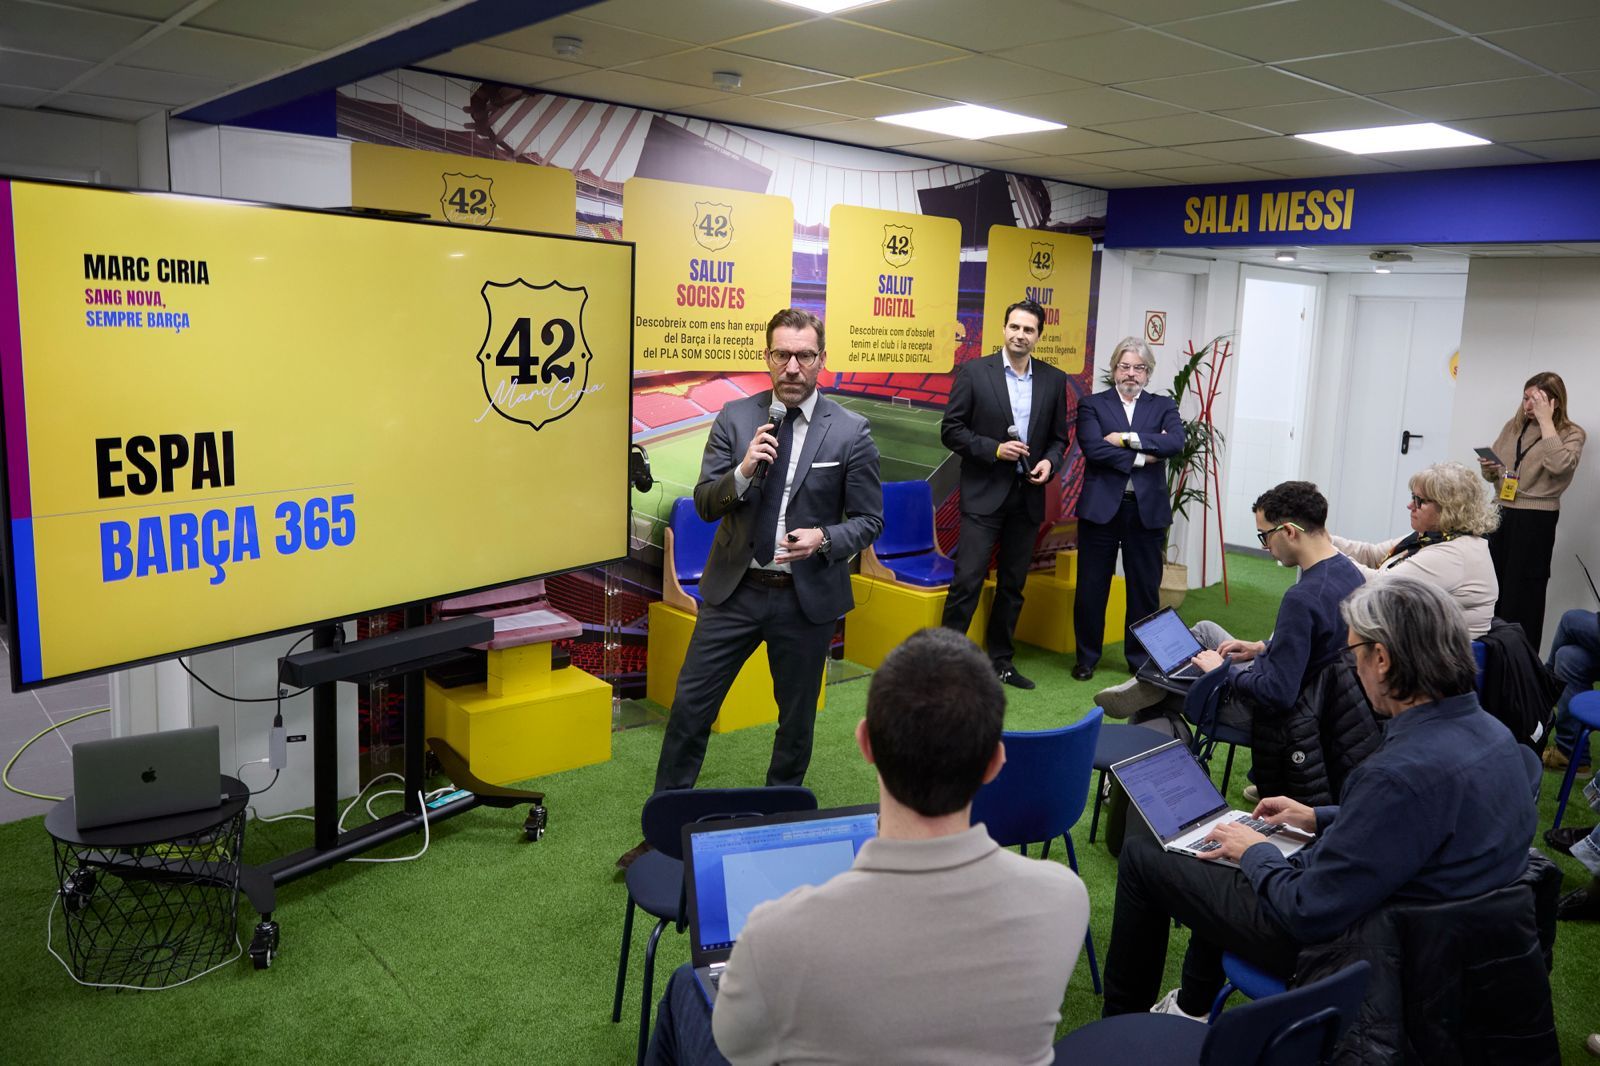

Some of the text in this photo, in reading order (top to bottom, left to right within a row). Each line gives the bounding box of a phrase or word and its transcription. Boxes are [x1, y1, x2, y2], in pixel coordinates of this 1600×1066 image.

[449, 187, 487, 215] 42
[1184, 188, 1355, 235] SALA MESSI
[698, 214, 729, 238] 42
[886, 235, 909, 256] 42
[84, 253, 210, 285] MARC CIRIA
[689, 258, 735, 283] SALUT
[1032, 251, 1050, 269] 42
[878, 274, 914, 295] SALUT
[85, 288, 166, 309] SANG NOVA,
[676, 283, 745, 309] SOCIS/ES
[1025, 286, 1054, 305] SALUT
[873, 296, 916, 318] DIGITAL
[86, 310, 190, 333] SEMPRE BARÇA
[635, 316, 767, 334] Descobreix com ens han expul
[849, 325, 935, 338] Descobreix com d'obsolet
[664, 332, 678, 344] del
[680, 333, 706, 346] Barça
[713, 334, 721, 345] la
[723, 336, 754, 348] recepta
[851, 339, 871, 349] tenim
[872, 339, 879, 349] el
[880, 340, 895, 349] club
[901, 340, 907, 350] la
[908, 341, 933, 352] recepta
[1037, 345, 1054, 353] nostra
[1055, 345, 1077, 355] llegenda
[495, 317, 576, 385] 42
[643, 347, 657, 358] del
[660, 348, 679, 359] PLA
[681, 348, 702, 360] SOM
[704, 349, 731, 360] SOCIS
[848, 352, 933, 363] del PLA IMPULS DIGITAL.
[95, 430, 235, 499] ESPAI
[100, 493, 356, 585] BARÇA 365
